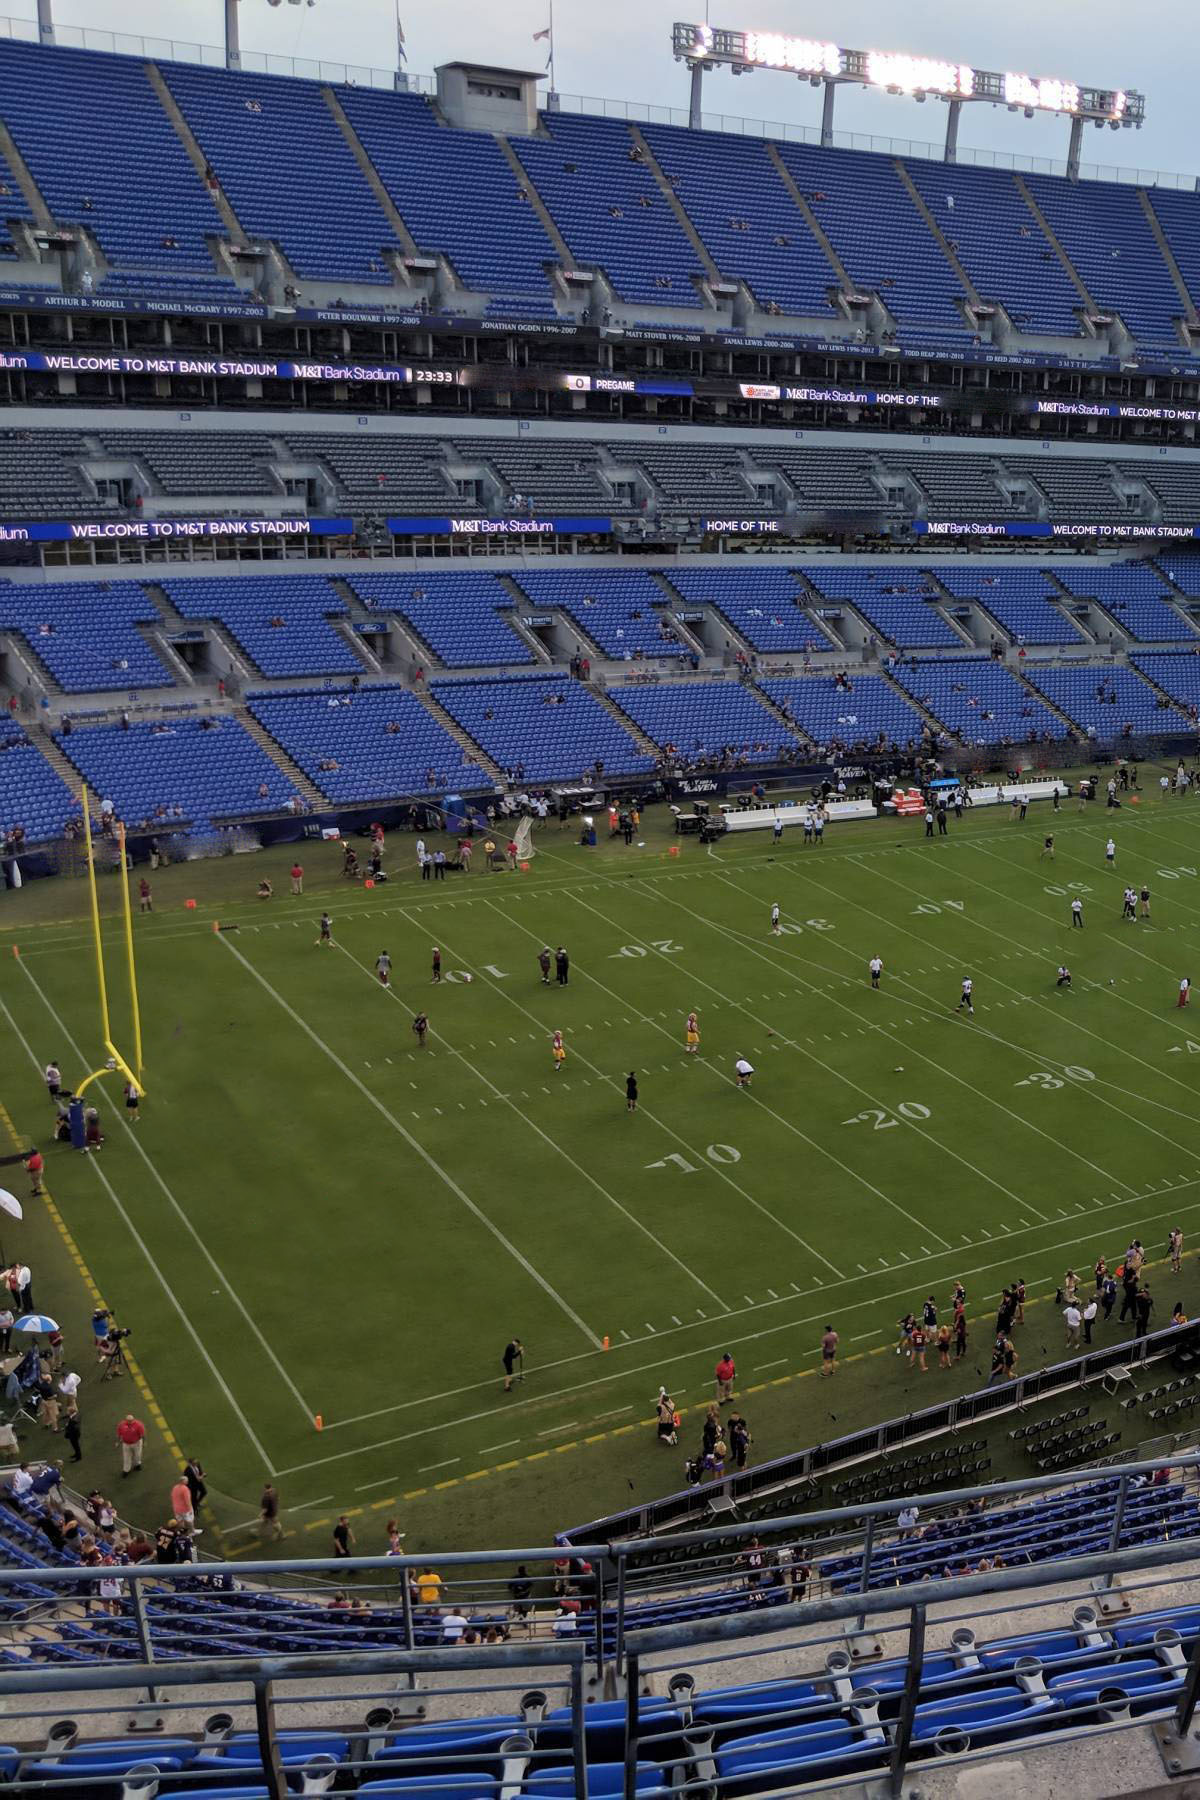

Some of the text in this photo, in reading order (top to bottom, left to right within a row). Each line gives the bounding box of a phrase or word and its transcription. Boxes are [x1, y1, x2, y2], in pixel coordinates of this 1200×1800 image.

[45, 297, 79, 306] ARTHUR
[92, 300, 125, 308] MODELL
[147, 302, 264, 316] MICHAEL McCRARY 1997-2002
[317, 312, 420, 325] PETER BOULWARE 1997-2005
[481, 322, 577, 335] JONATHAN OGDEN 1996-2007
[644, 332, 667, 340] STOVER
[745, 339, 762, 347] LEWIS
[46, 356, 277, 376] WELCOME TO M&T BANK STADIUM
[293, 363, 400, 380] M&T Bank Stadium
[416, 371, 453, 382] 23:33
[576, 378, 584, 389] 0
[596, 379, 635, 390] PREGAME
[786, 388, 810, 399] M&T
[810, 390, 832, 401] Bank
[832, 391, 867, 403] Stadium
[876, 394, 939, 405] HOME OF THE
[1038, 401, 1109, 415] M&T Bank Stadium
[1120, 407, 1161, 418] WELCOME
[1163, 409, 1176, 418] TO
[1177, 411, 1196, 420] M&T
[72, 521, 310, 537] WELCOME TO M&T BANK STADIUM
[451, 519, 553, 532] M&T Bank Stadium
[707, 521, 778, 531] HOME OF THE
[928, 522, 1005, 534] M&T Bank Stadium
[1053, 525, 1193, 537] WELCOME TO M&T BANK STADIUM
[838, 770, 867, 779] RAVEN
[683, 784, 718, 793] RAVEN
[1155, 866, 1199, 881] 40
[1043, 882, 1094, 897] 50
[919, 899, 966, 916] 40
[782, 918, 837, 935] 30
[618, 939, 685, 959] 20
[444, 964, 511, 984] 10
[1028, 1065, 1096, 1090] 30
[857, 1102, 932, 1131] 20
[662, 1143, 742, 1174] 10
[749, 1554, 762, 1566] 44
